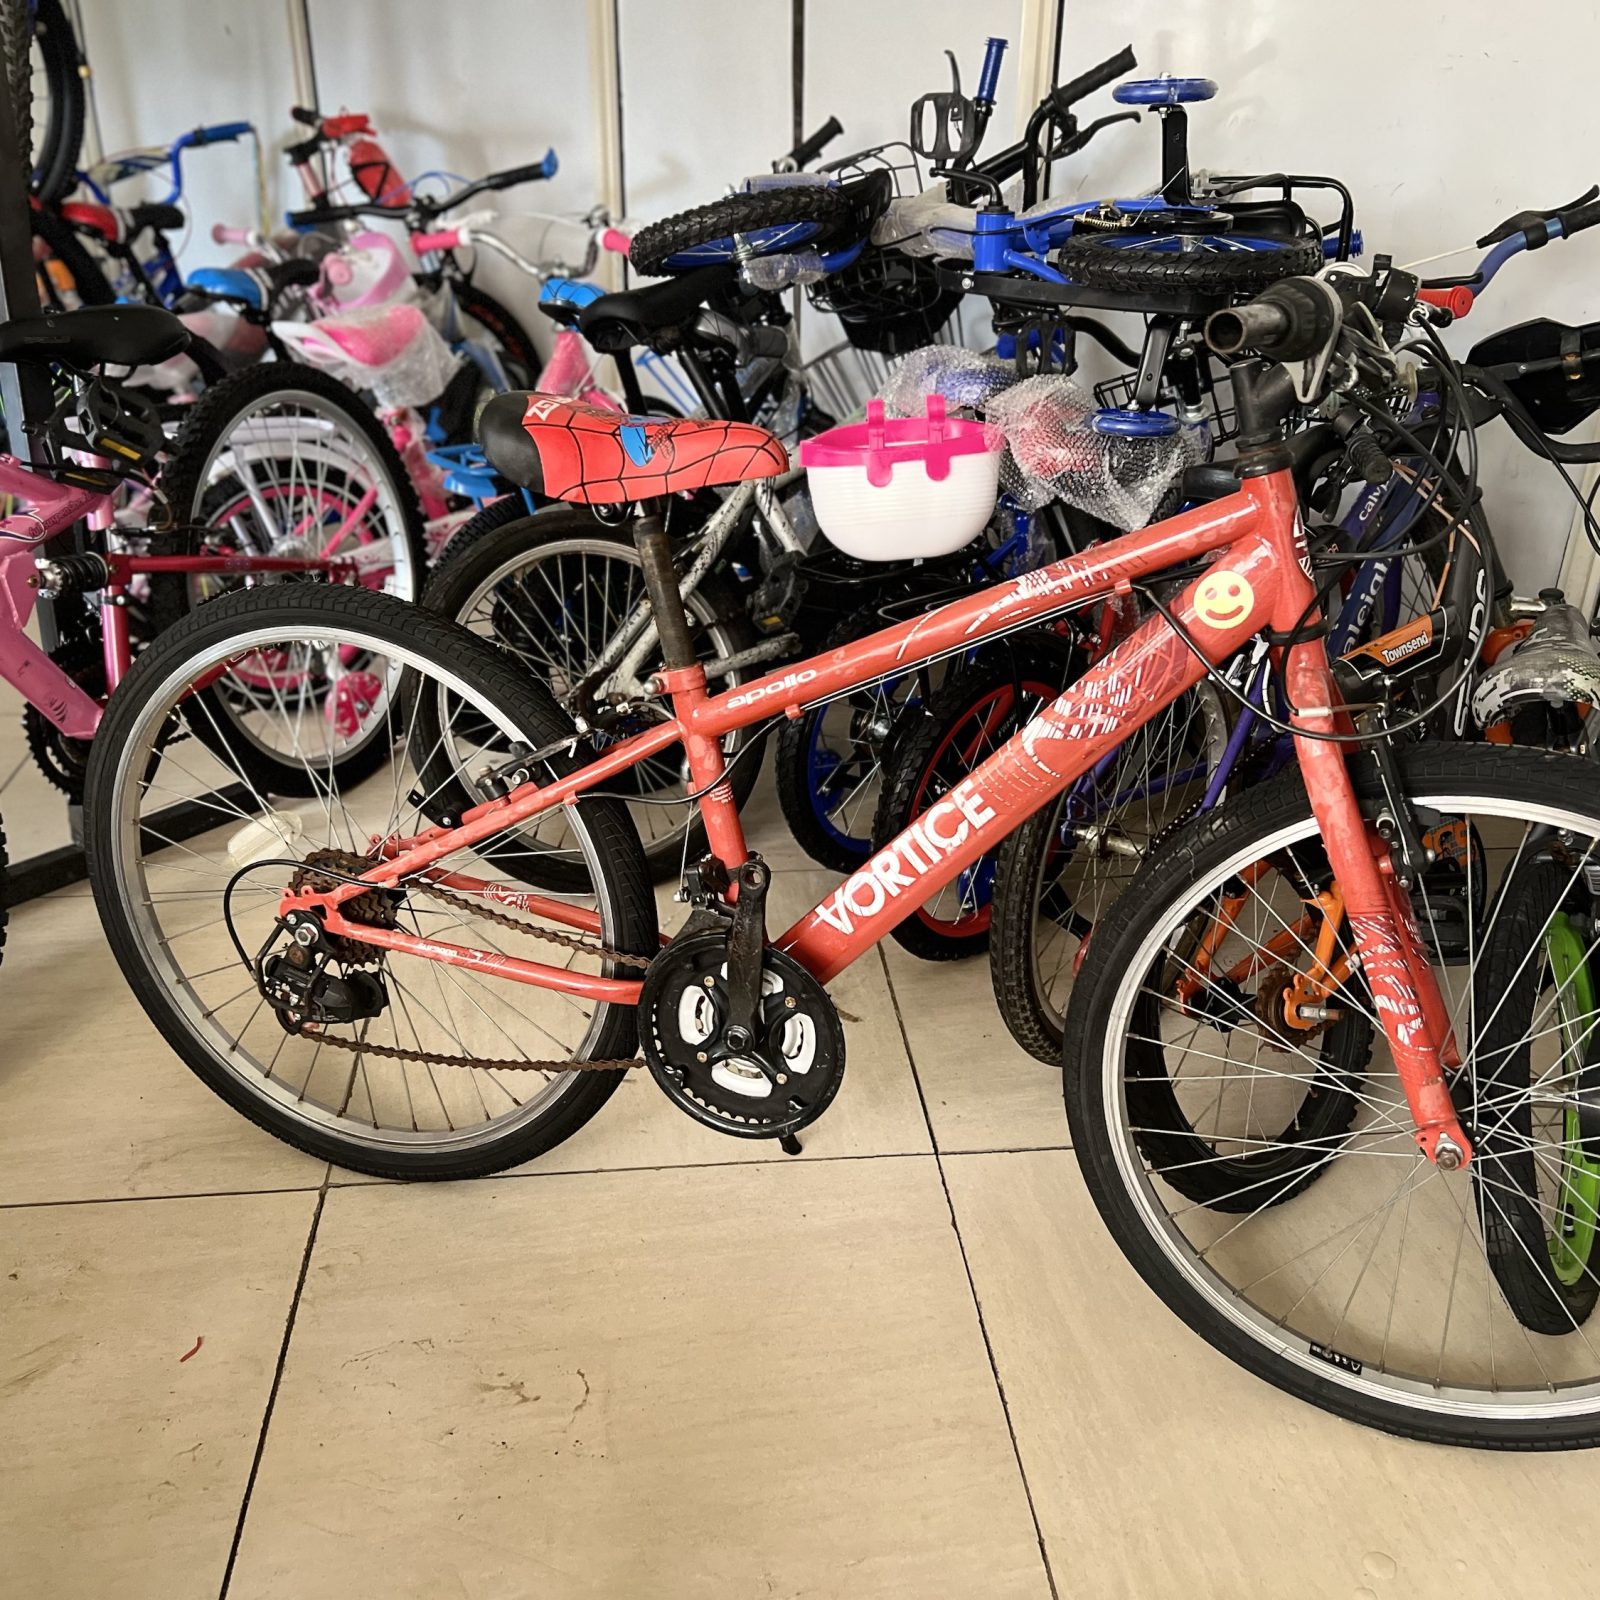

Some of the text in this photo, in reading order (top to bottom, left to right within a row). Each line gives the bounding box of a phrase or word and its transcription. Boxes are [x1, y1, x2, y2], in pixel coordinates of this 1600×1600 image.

[1381, 631, 1428, 663] Townsend
[727, 669, 816, 709] apollo
[811, 779, 997, 935] VORTICE
